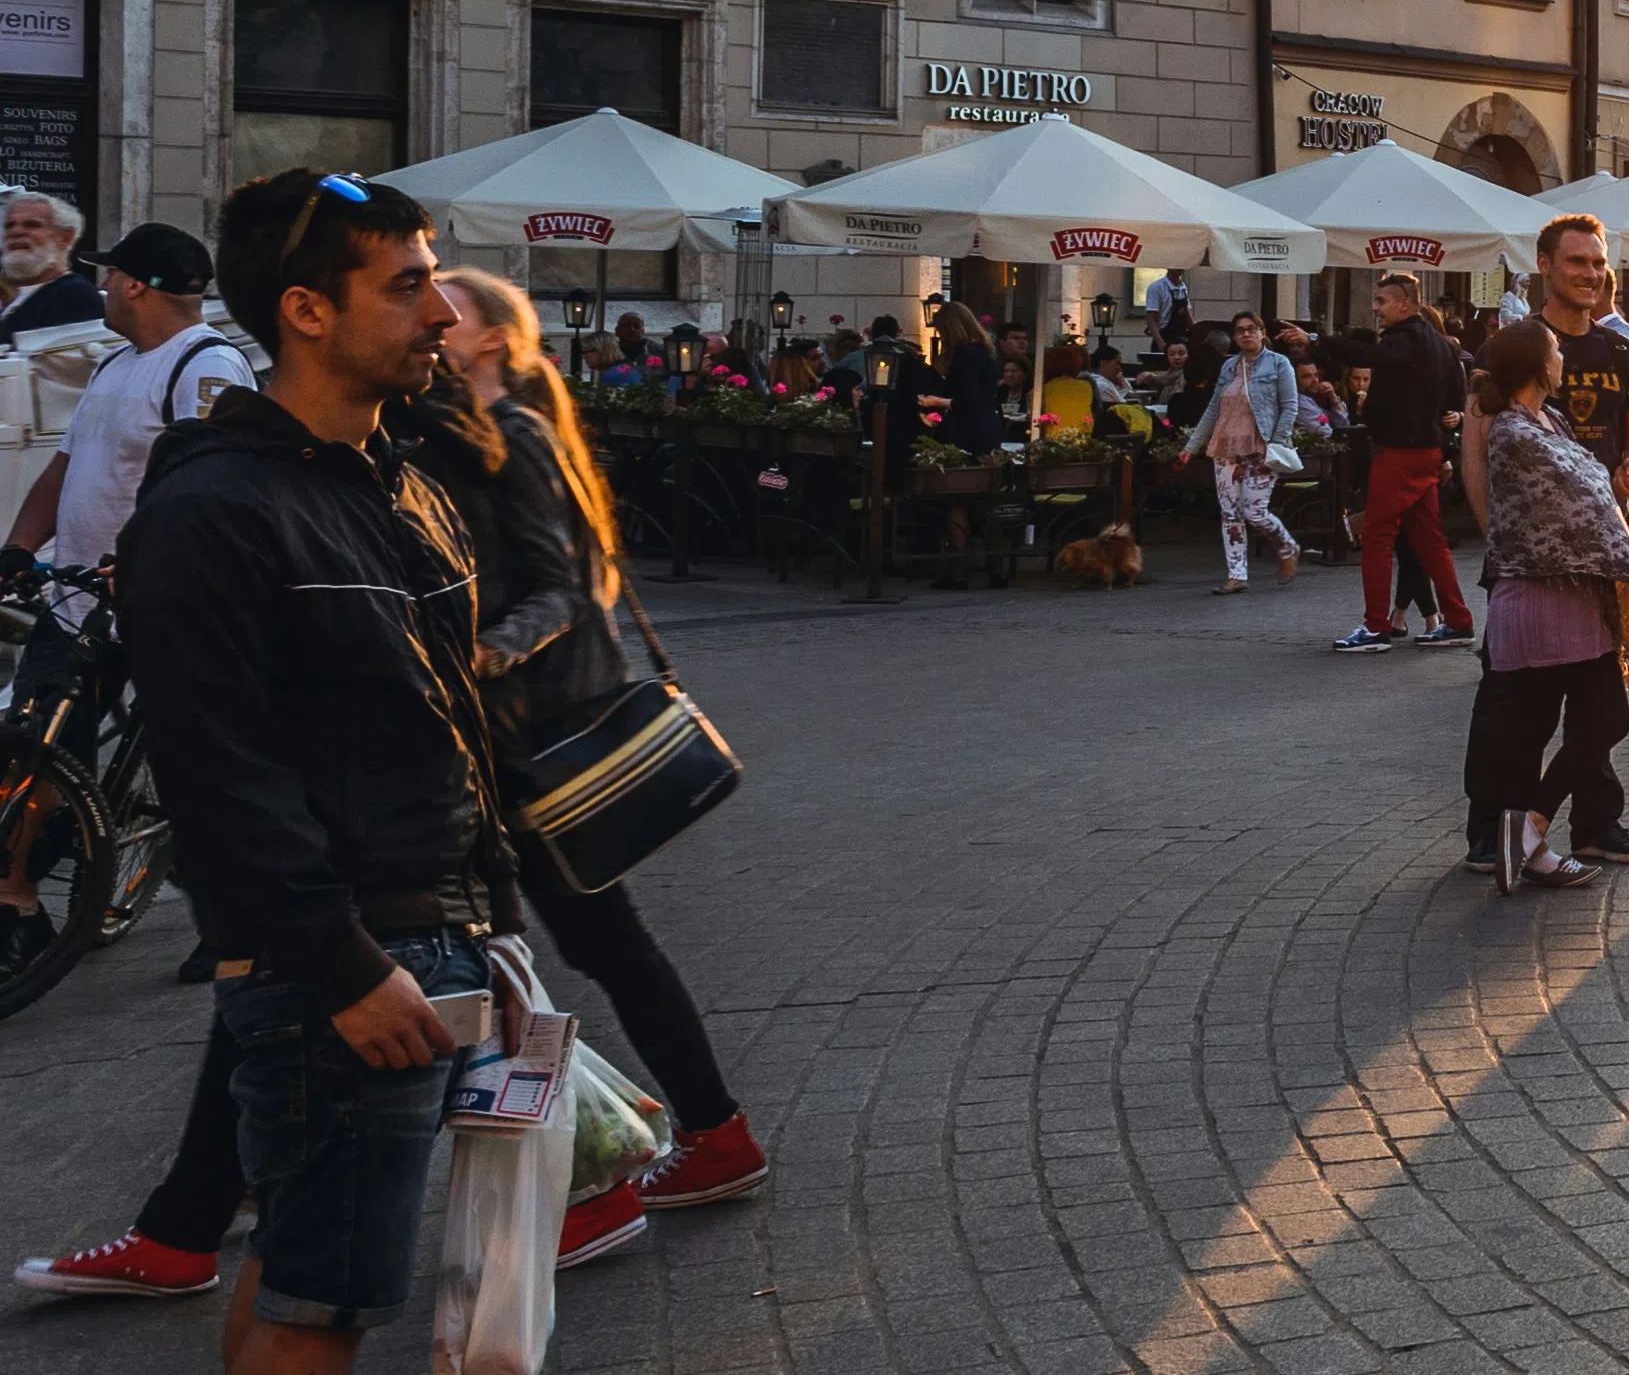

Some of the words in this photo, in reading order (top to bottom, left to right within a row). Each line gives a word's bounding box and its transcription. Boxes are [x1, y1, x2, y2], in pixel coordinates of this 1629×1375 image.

[928, 63, 973, 96] DA
[980, 66, 1092, 104] PIETRO
[1313, 90, 1385, 117] CRACOW
[3, 107, 77, 121] SOUVENIRS
[950, 106, 1070, 125] restauraa
[40, 122, 74, 133] FOTO
[34, 134, 68, 146] BAGS
[535, 214, 605, 235] ŻYWIEC
[845, 216, 867, 231] DA
[870, 218, 923, 235] PIETRO
[1062, 231, 1132, 253] ŻYWIEC
[1243, 241, 1256, 254] DA
[1258, 242, 1289, 255] PIETRO
[1375, 238, 1437, 257] ŻYWIEC
